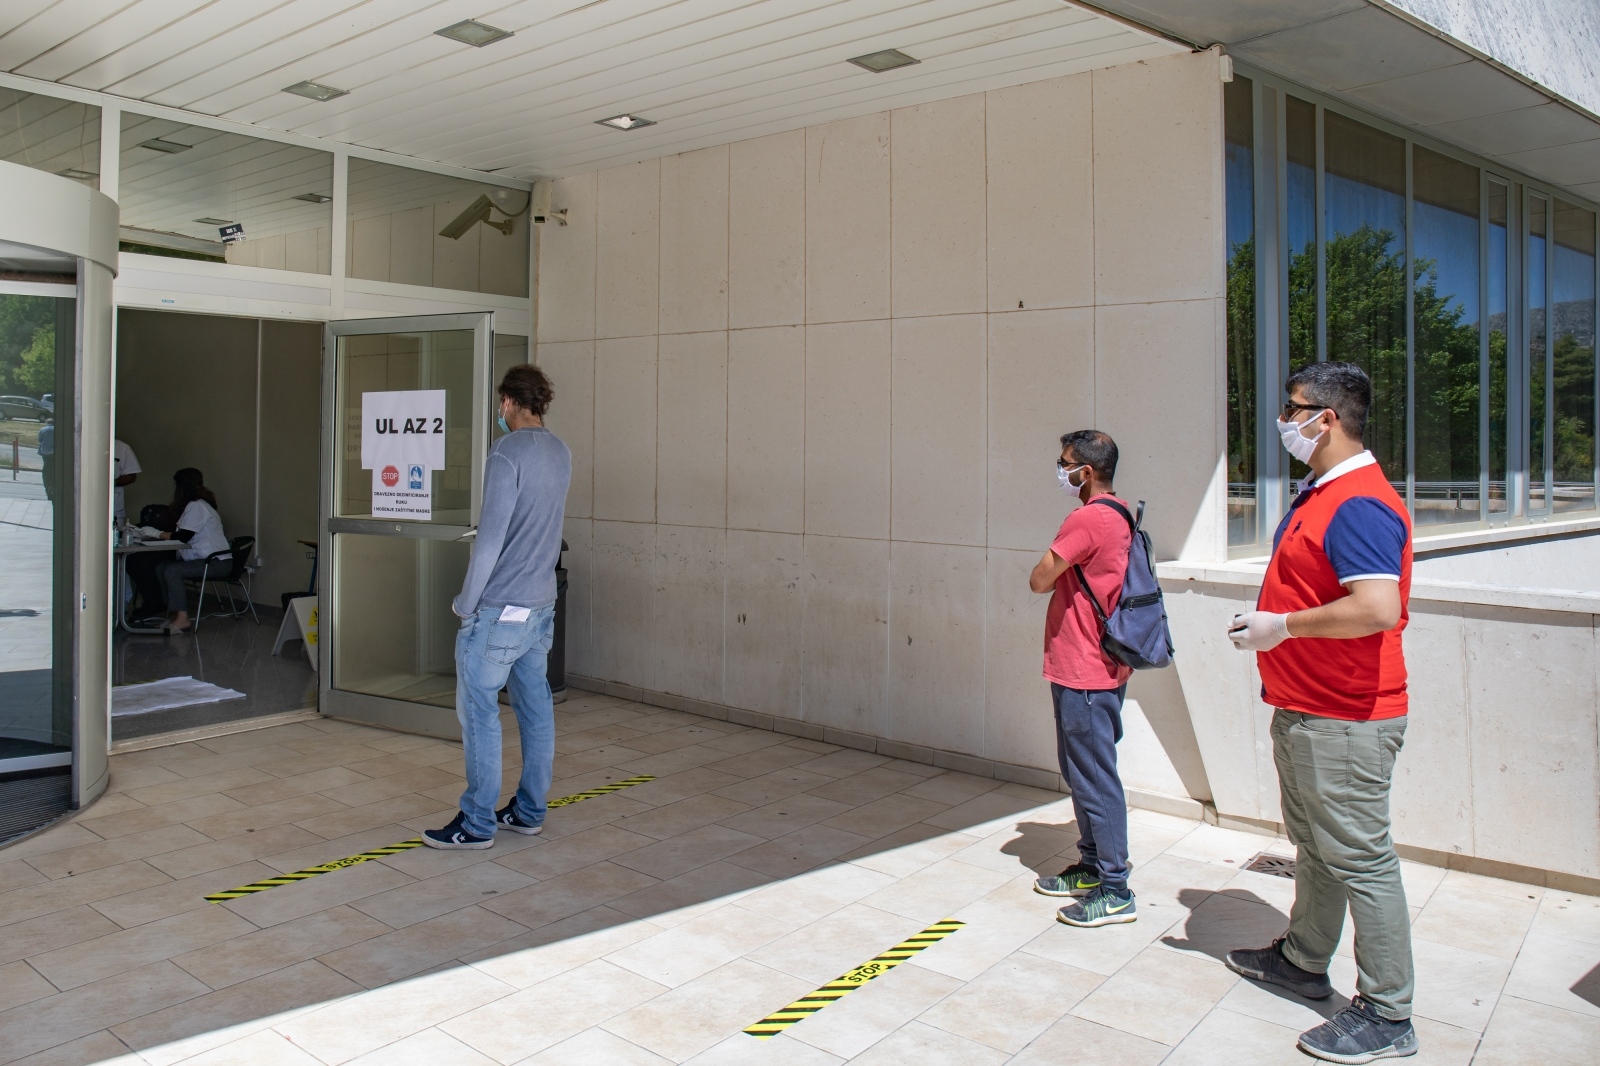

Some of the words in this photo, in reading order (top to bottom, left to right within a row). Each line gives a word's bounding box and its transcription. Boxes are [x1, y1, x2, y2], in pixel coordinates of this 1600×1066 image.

[433, 417, 443, 434] 2
[553, 796, 581, 805] STOP
[326, 856, 362, 869] STOP
[847, 963, 881, 983] STOP
